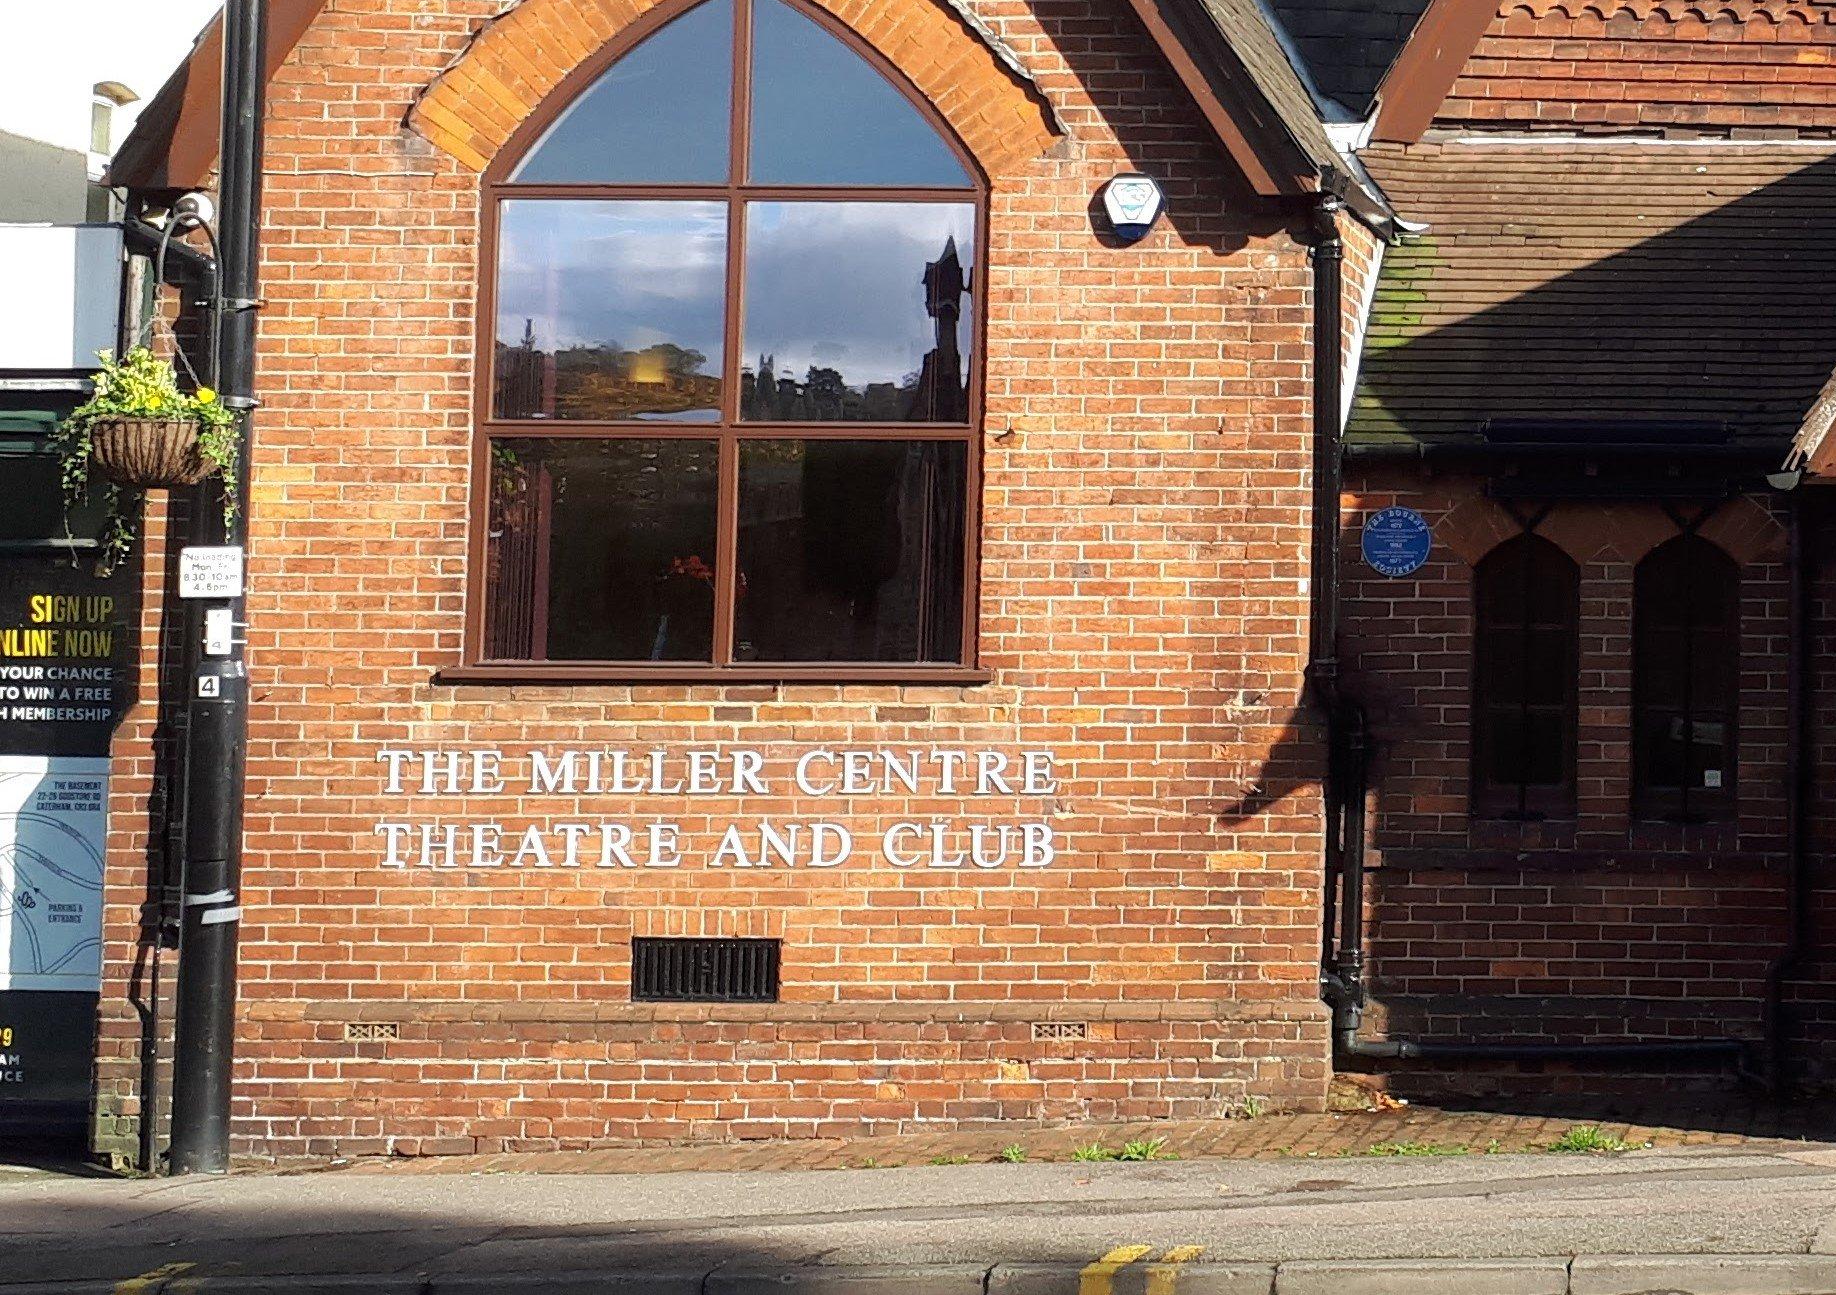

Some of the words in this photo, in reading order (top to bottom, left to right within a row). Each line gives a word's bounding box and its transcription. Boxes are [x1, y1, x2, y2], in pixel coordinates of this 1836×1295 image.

[31, 595, 80, 623] SIGN
[86, 595, 113, 623] UP
[64, 629, 112, 657] NOW
[0, 666, 45, 680] YOUR
[47, 667, 113, 681] CHANCE
[0, 686, 20, 700] TO
[23, 686, 55, 700] WIN
[59, 687, 71, 701] A
[74, 687, 112, 701] FREE
[202, 677, 216, 695] 4
[12, 707, 112, 722] MEMBERSHIP
[377, 749, 506, 794] THE
[526, 749, 770, 795] MILLER
[795, 749, 1058, 796] CENTRE
[374, 822, 683, 869] THEATRE
[708, 822, 853, 869] AND
[882, 821, 1055, 869] CLUB
